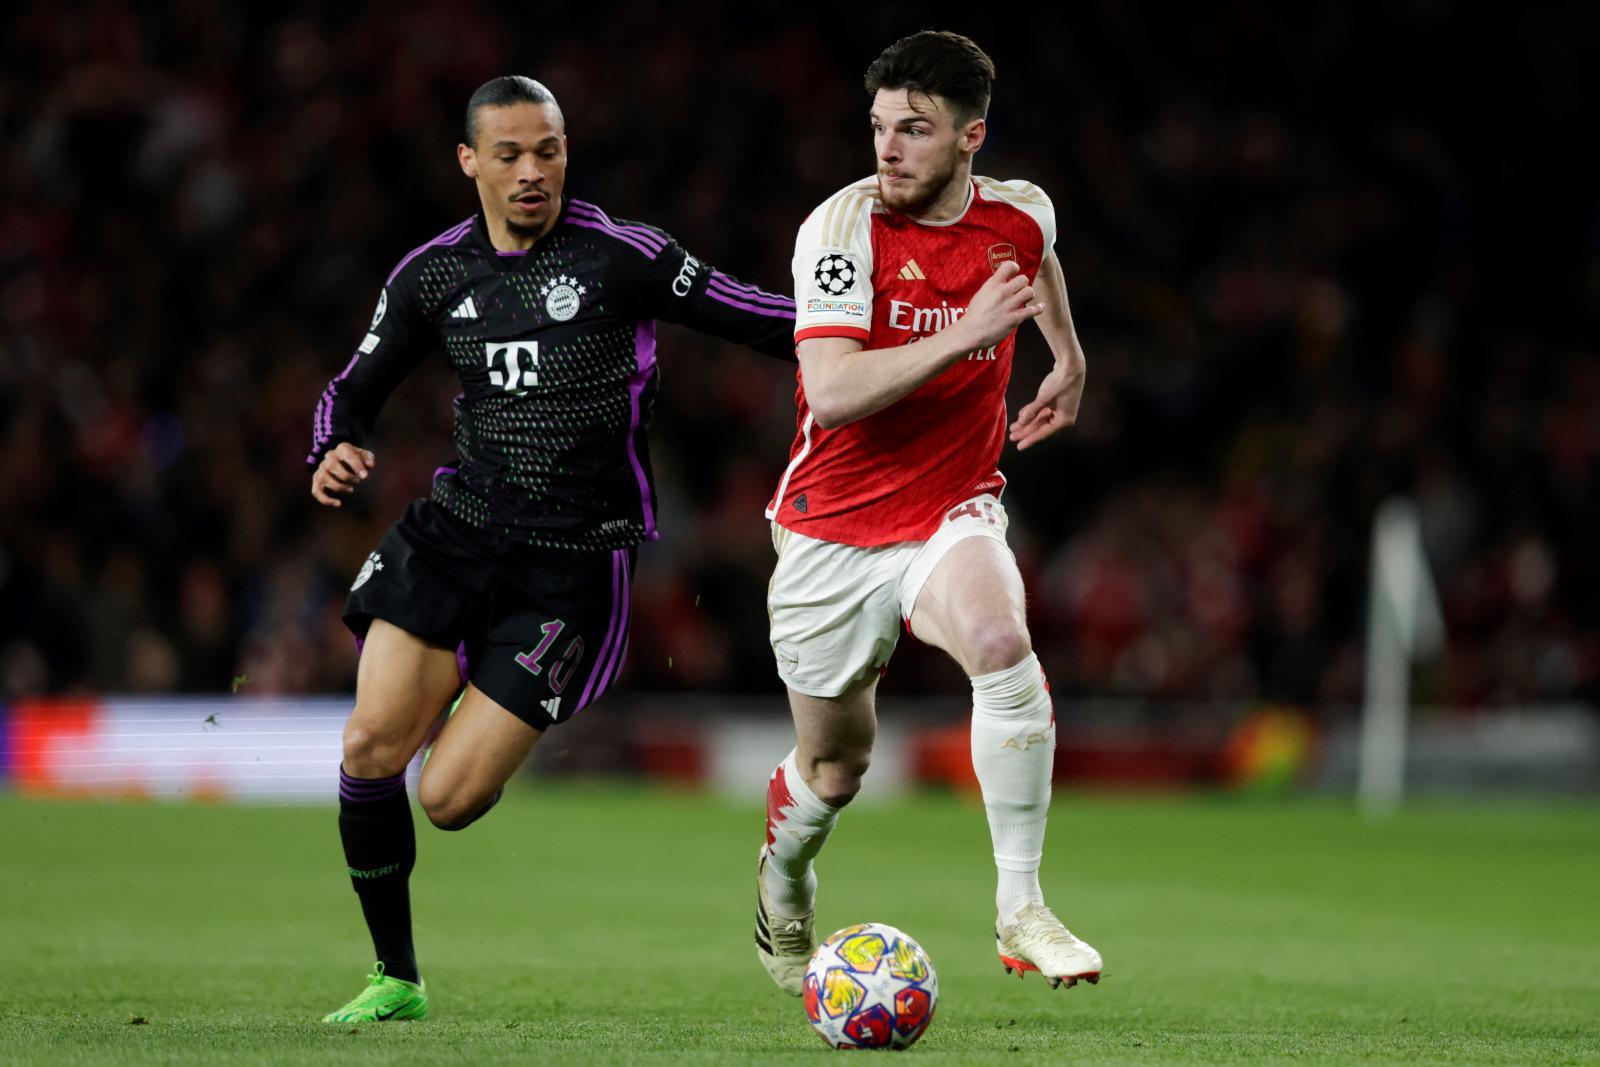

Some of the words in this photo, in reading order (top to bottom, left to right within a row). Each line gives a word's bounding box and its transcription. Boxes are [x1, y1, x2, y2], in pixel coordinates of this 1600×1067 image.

[992, 250, 1012, 260] Arsenal
[807, 303, 864, 312] FOUNDATION
[514, 618, 585, 695] 10
